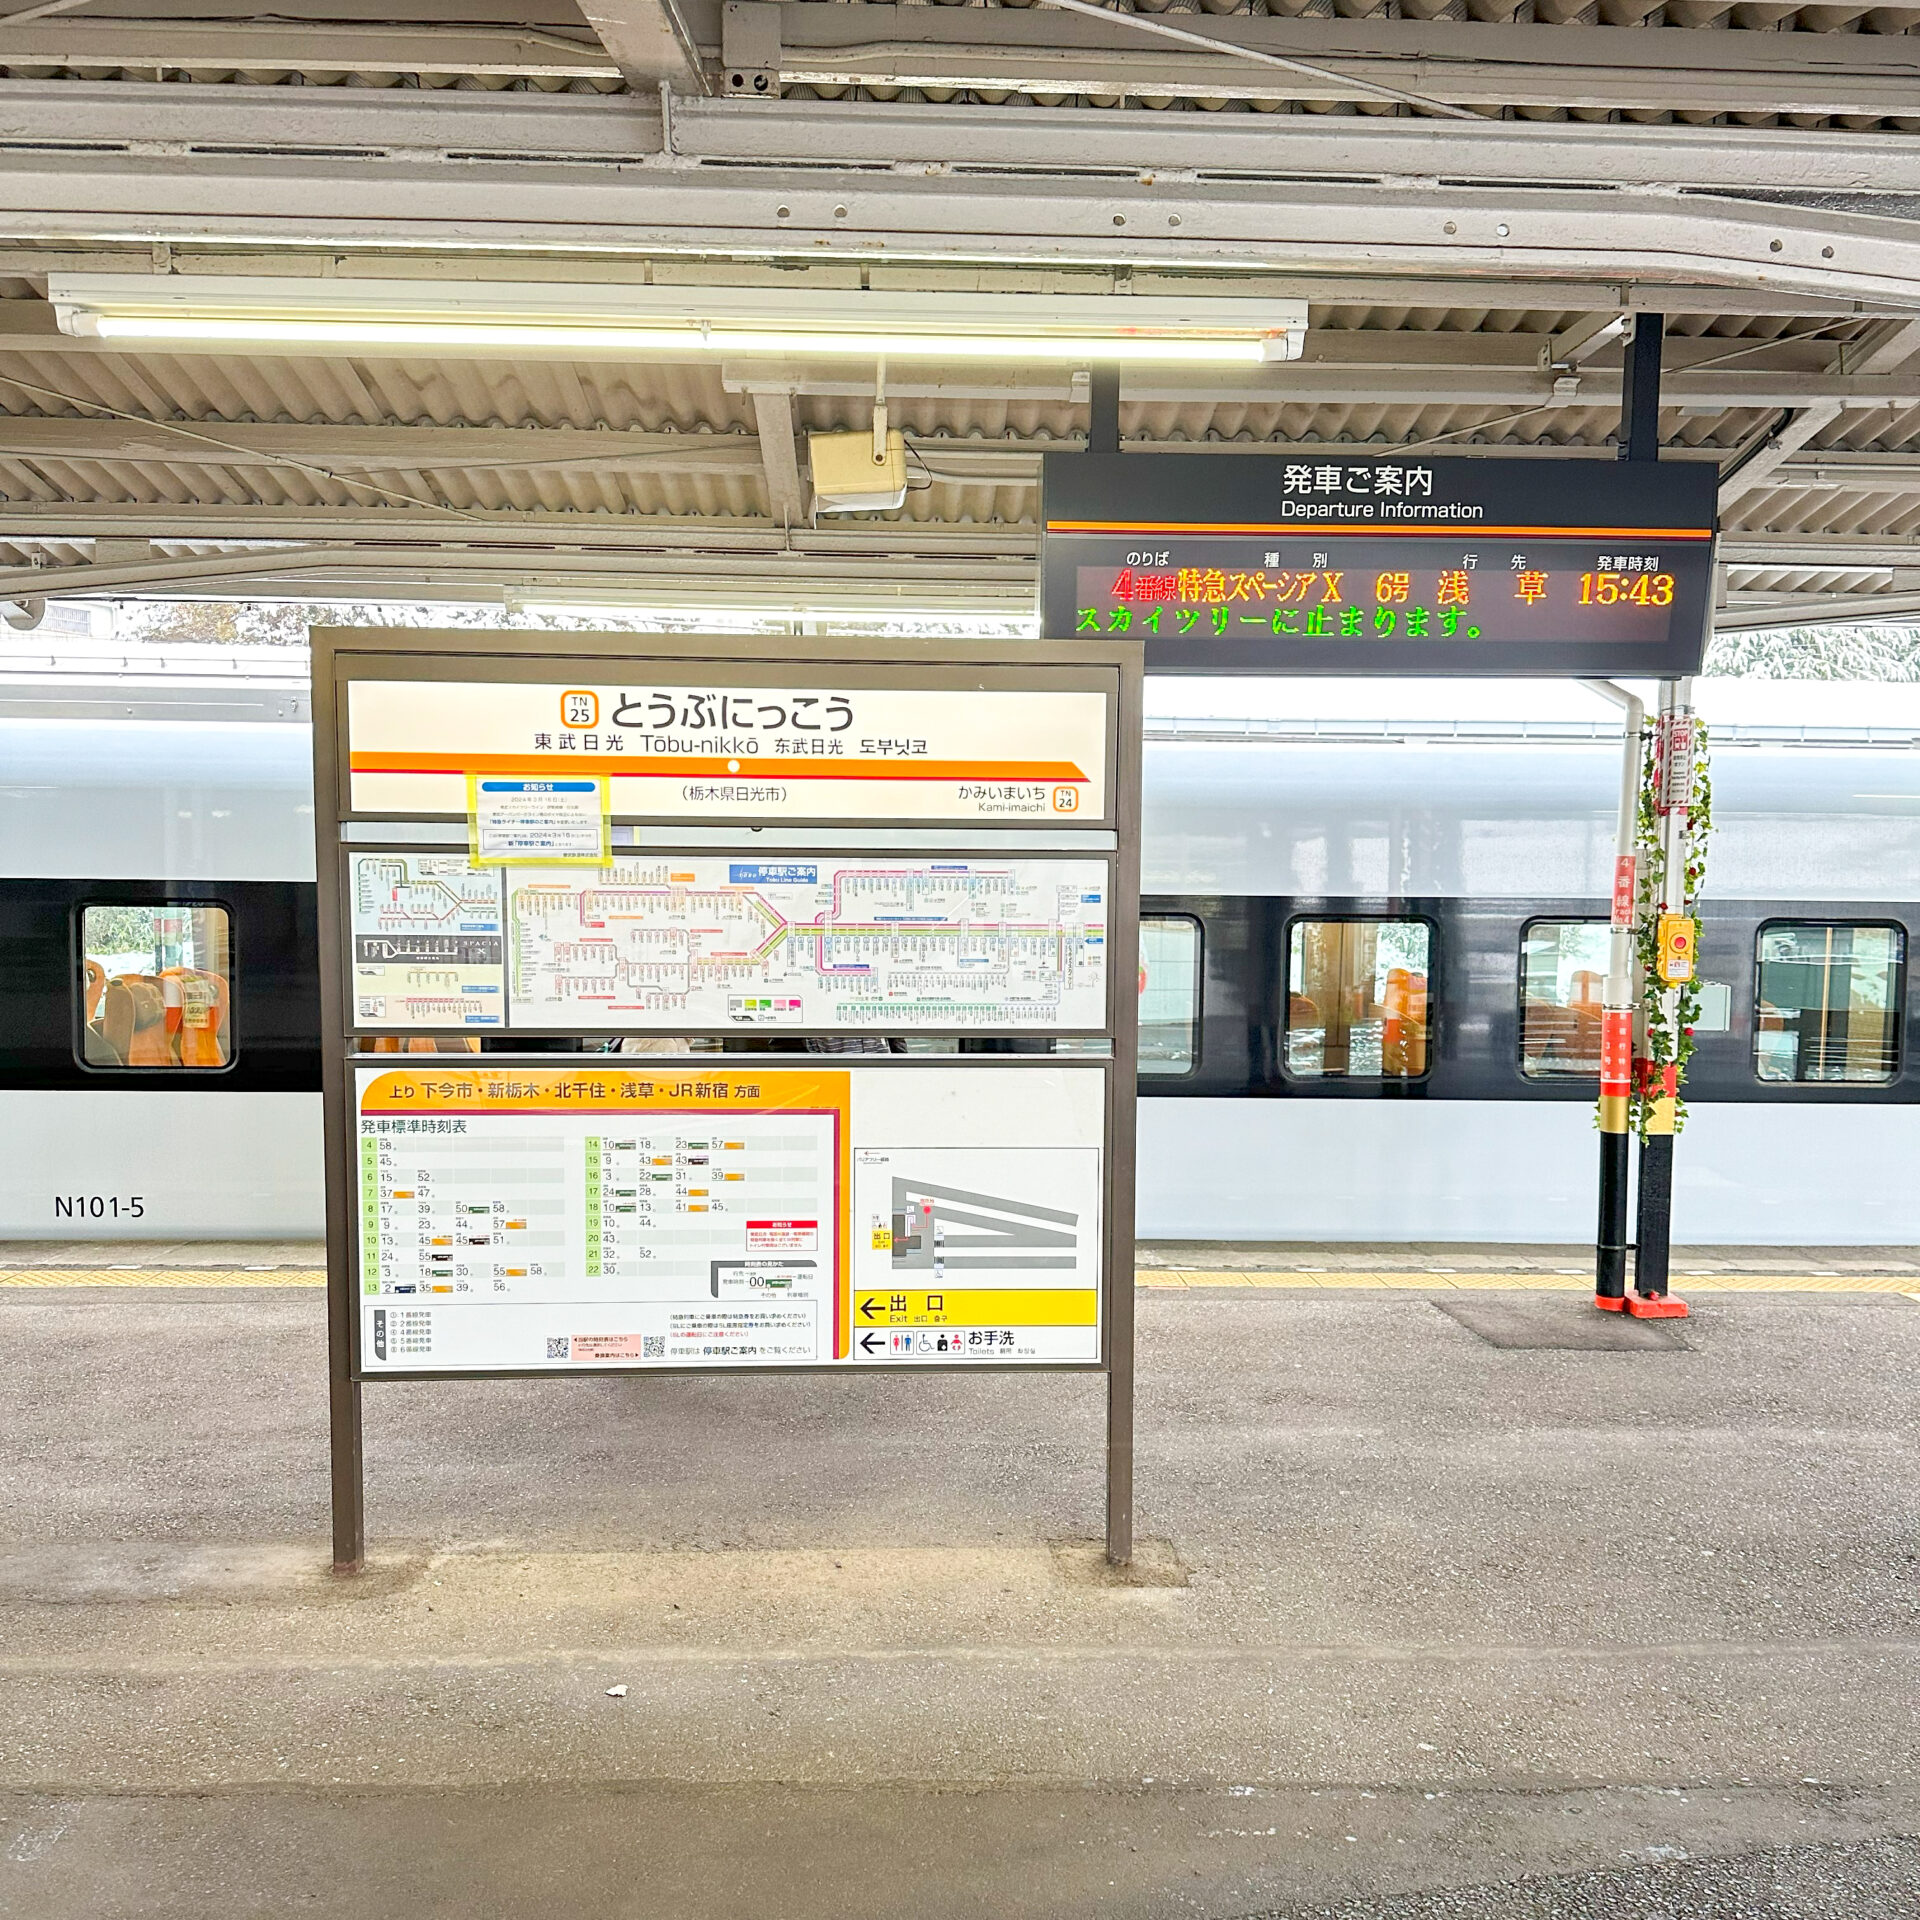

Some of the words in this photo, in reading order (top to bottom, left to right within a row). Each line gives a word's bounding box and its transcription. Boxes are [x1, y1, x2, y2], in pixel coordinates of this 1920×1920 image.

[1282, 464, 1434, 497] 発車ご案内
[1282, 501, 1374, 520] Departure
[1379, 501, 1484, 520] Information
[1126, 551, 1170, 566] のりば
[1264, 552, 1328, 568] 種別
[1463, 554, 1526, 570] 行先
[1597, 555, 1659, 573] 発車時刻
[1112, 569, 1177, 601] 4番線
[1376, 574, 1409, 603] 6号
[1437, 570, 1547, 606] 浅草
[1577, 574, 1674, 607] 15:43
[1074, 605, 1482, 639] スカイツリーに止まります。
[571, 697, 588, 706] TN
[570, 709, 590, 722] 25
[611, 692, 854, 733] とうぶにっこう
[534, 733, 624, 751] 東武日光
[640, 734, 759, 754] Tōbu-nikkō
[774, 738, 844, 755] 东武日光
[859, 739, 928, 755] 도부닛코
[522, 783, 554, 792] お知らせ
[958, 785, 1046, 800] かみいまいち
[978, 802, 1046, 813] Kami-imaichi
[1059, 797, 1073, 809] 24
[758, 866, 816, 877] 停車駅ご案内
[389, 1085, 415, 1099] 上り
[420, 1082, 729, 1099] 下今市・新栃木・北千住・浅草・JR新宿
[734, 1085, 760, 1098] 方面
[361, 1119, 467, 1134] 発車標準時刻表
[380, 1142, 391, 1150] 58
[604, 1141, 614, 1149] 10
[676, 1141, 689, 1150] 23
[676, 1156, 687, 1164] 43
[418, 1173, 429, 1181] 52
[640, 1172, 651, 1180] 22
[676, 1172, 685, 1180] 31
[712, 1172, 724, 1181] 39
[418, 1189, 430, 1197] 47
[603, 1188, 614, 1197] 24
[640, 1188, 651, 1196] 28
[54, 1196, 145, 1218] N101-5
[382, 1205, 392, 1213] 17
[419, 1205, 430, 1213] 39
[493, 1204, 504, 1212] 58
[641, 1203, 651, 1211] 13
[384, 1221, 390, 1229] 9
[419, 1221, 430, 1229] 23
[456, 1220, 467, 1228] 44
[494, 1220, 504, 1228] 57
[605, 1219, 615, 1227] 10
[456, 1236, 467, 1244] 45
[494, 1236, 503, 1244] 51
[603, 1235, 615, 1243] 43
[382, 1253, 393, 1261] 24
[640, 1250, 651, 1258] 52
[421, 1268, 431, 1276] 18
[457, 1268, 468, 1276] 30
[494, 1267, 505, 1275] 55
[604, 1266, 615, 1274] 30
[384, 1284, 392, 1293] 2
[420, 1284, 431, 1292] 35
[494, 1283, 505, 1291] 56
[890, 1294, 943, 1312] 出口
[890, 1315, 908, 1323] Exit
[376, 1320, 385, 1348] その他
[968, 1330, 1014, 1346] お手洗
[703, 1346, 757, 1355] 停車駅ご案内
